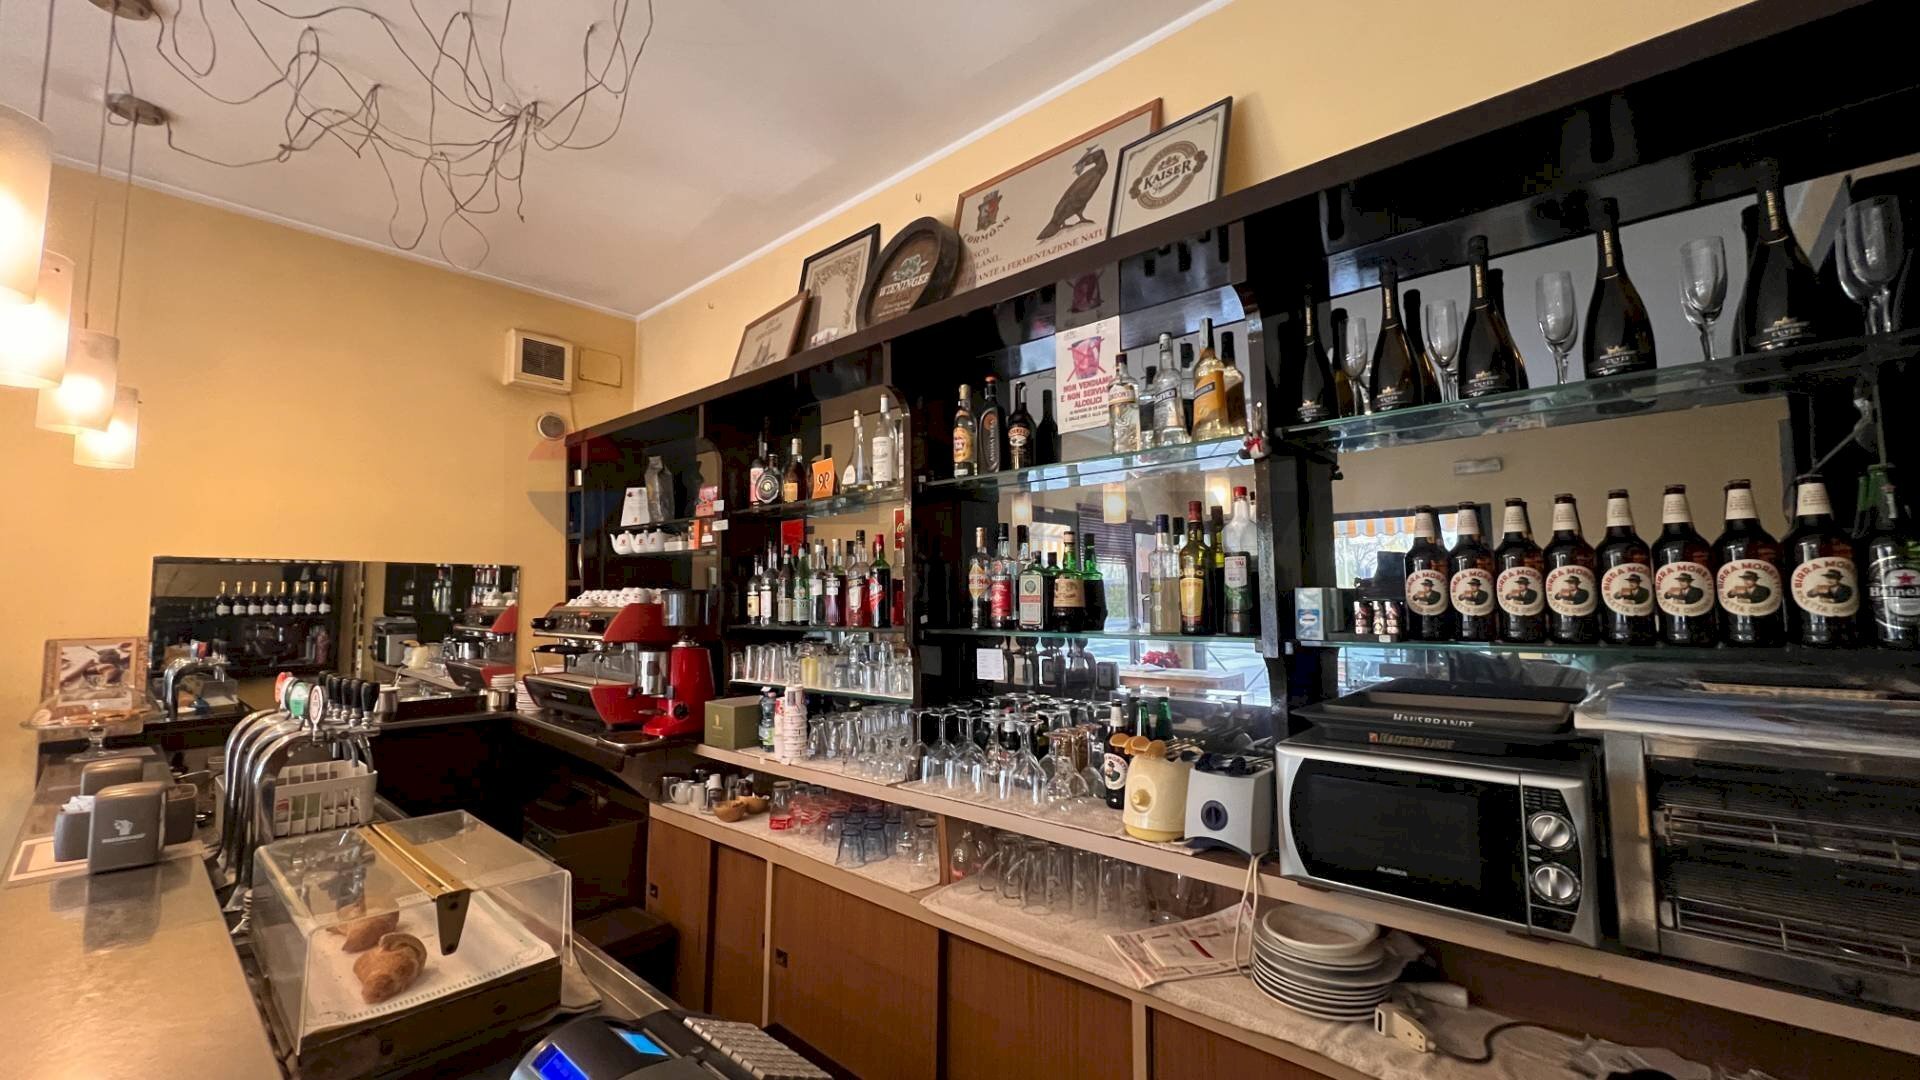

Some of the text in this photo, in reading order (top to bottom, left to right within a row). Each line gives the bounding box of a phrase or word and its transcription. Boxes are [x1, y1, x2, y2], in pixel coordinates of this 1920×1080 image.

[1143, 159, 1192, 191] KAISER
[1007, 237, 1079, 271] FERMENTAZIONE
[1074, 397, 1102, 408] ALCOLICI
[1603, 568, 1625, 591] BIRRA
[1718, 565, 1738, 590] BIRRA
[1794, 563, 1822, 588] BIRRA
